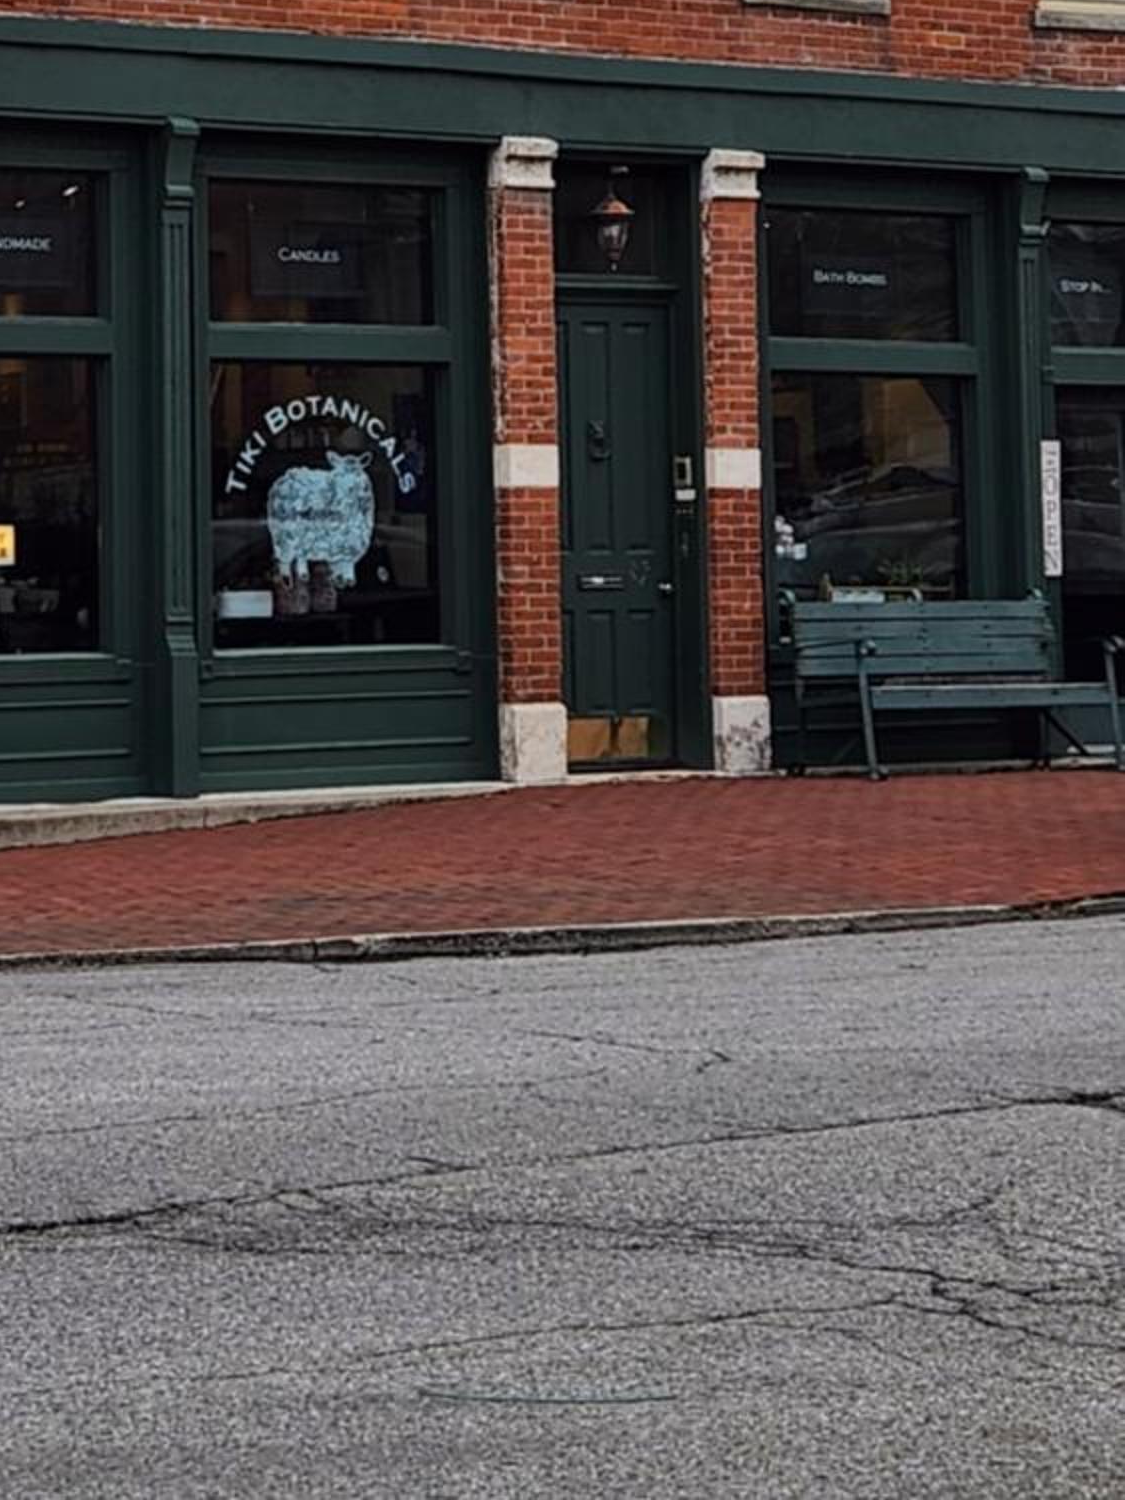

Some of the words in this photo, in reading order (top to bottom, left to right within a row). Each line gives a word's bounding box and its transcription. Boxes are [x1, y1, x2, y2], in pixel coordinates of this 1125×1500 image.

[278, 246, 340, 263] CANDLES
[225, 431, 267, 494] TIKI
[264, 395, 416, 494] BOTANICALS
